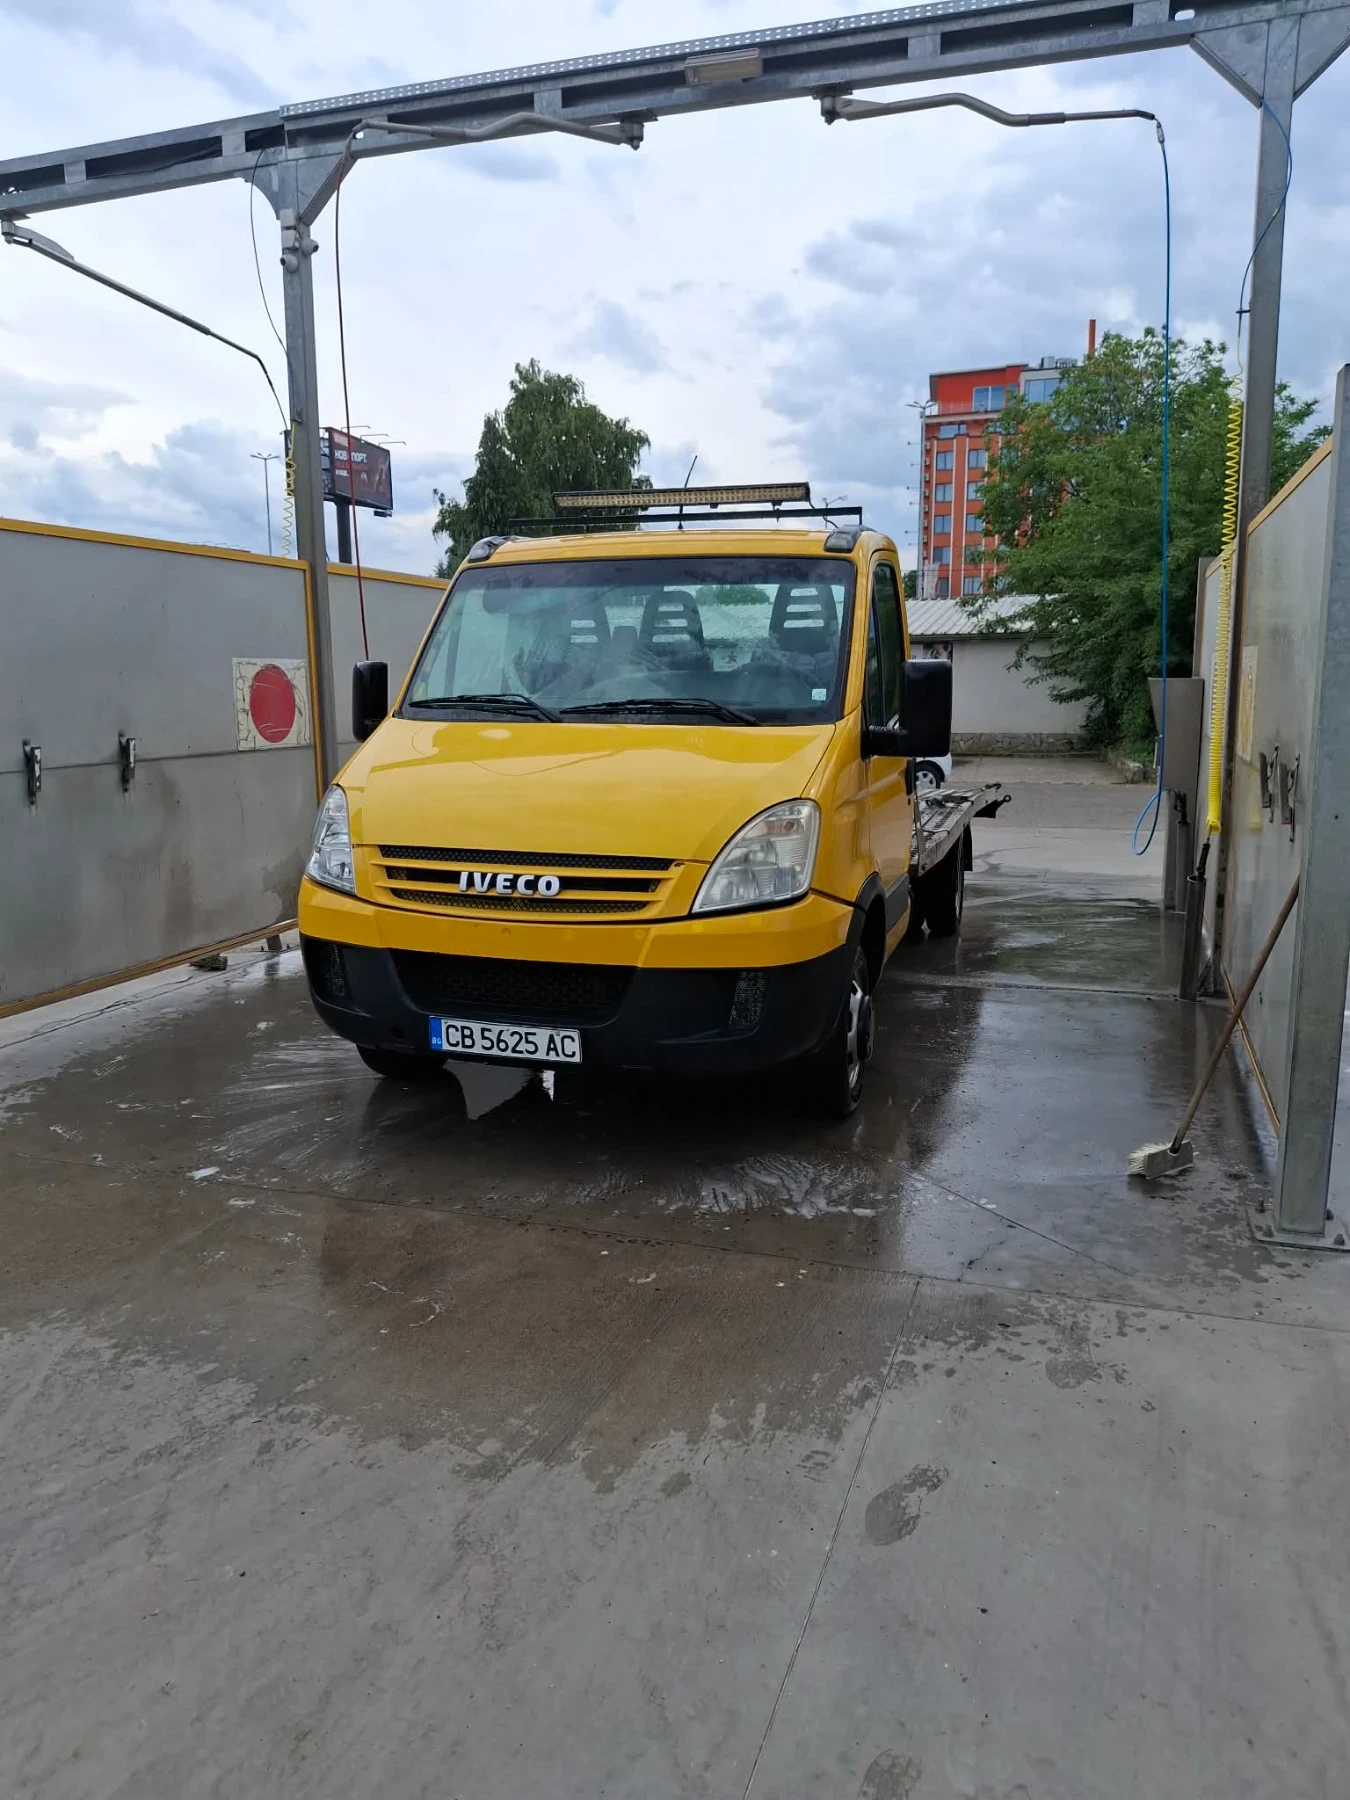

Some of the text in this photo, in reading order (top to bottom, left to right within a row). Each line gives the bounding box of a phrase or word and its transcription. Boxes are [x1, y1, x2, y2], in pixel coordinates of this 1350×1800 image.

[459, 871, 560, 897] IVECO
[431, 1036, 442, 1045] BG
[445, 1025, 576, 1058] CB 5625 AC
